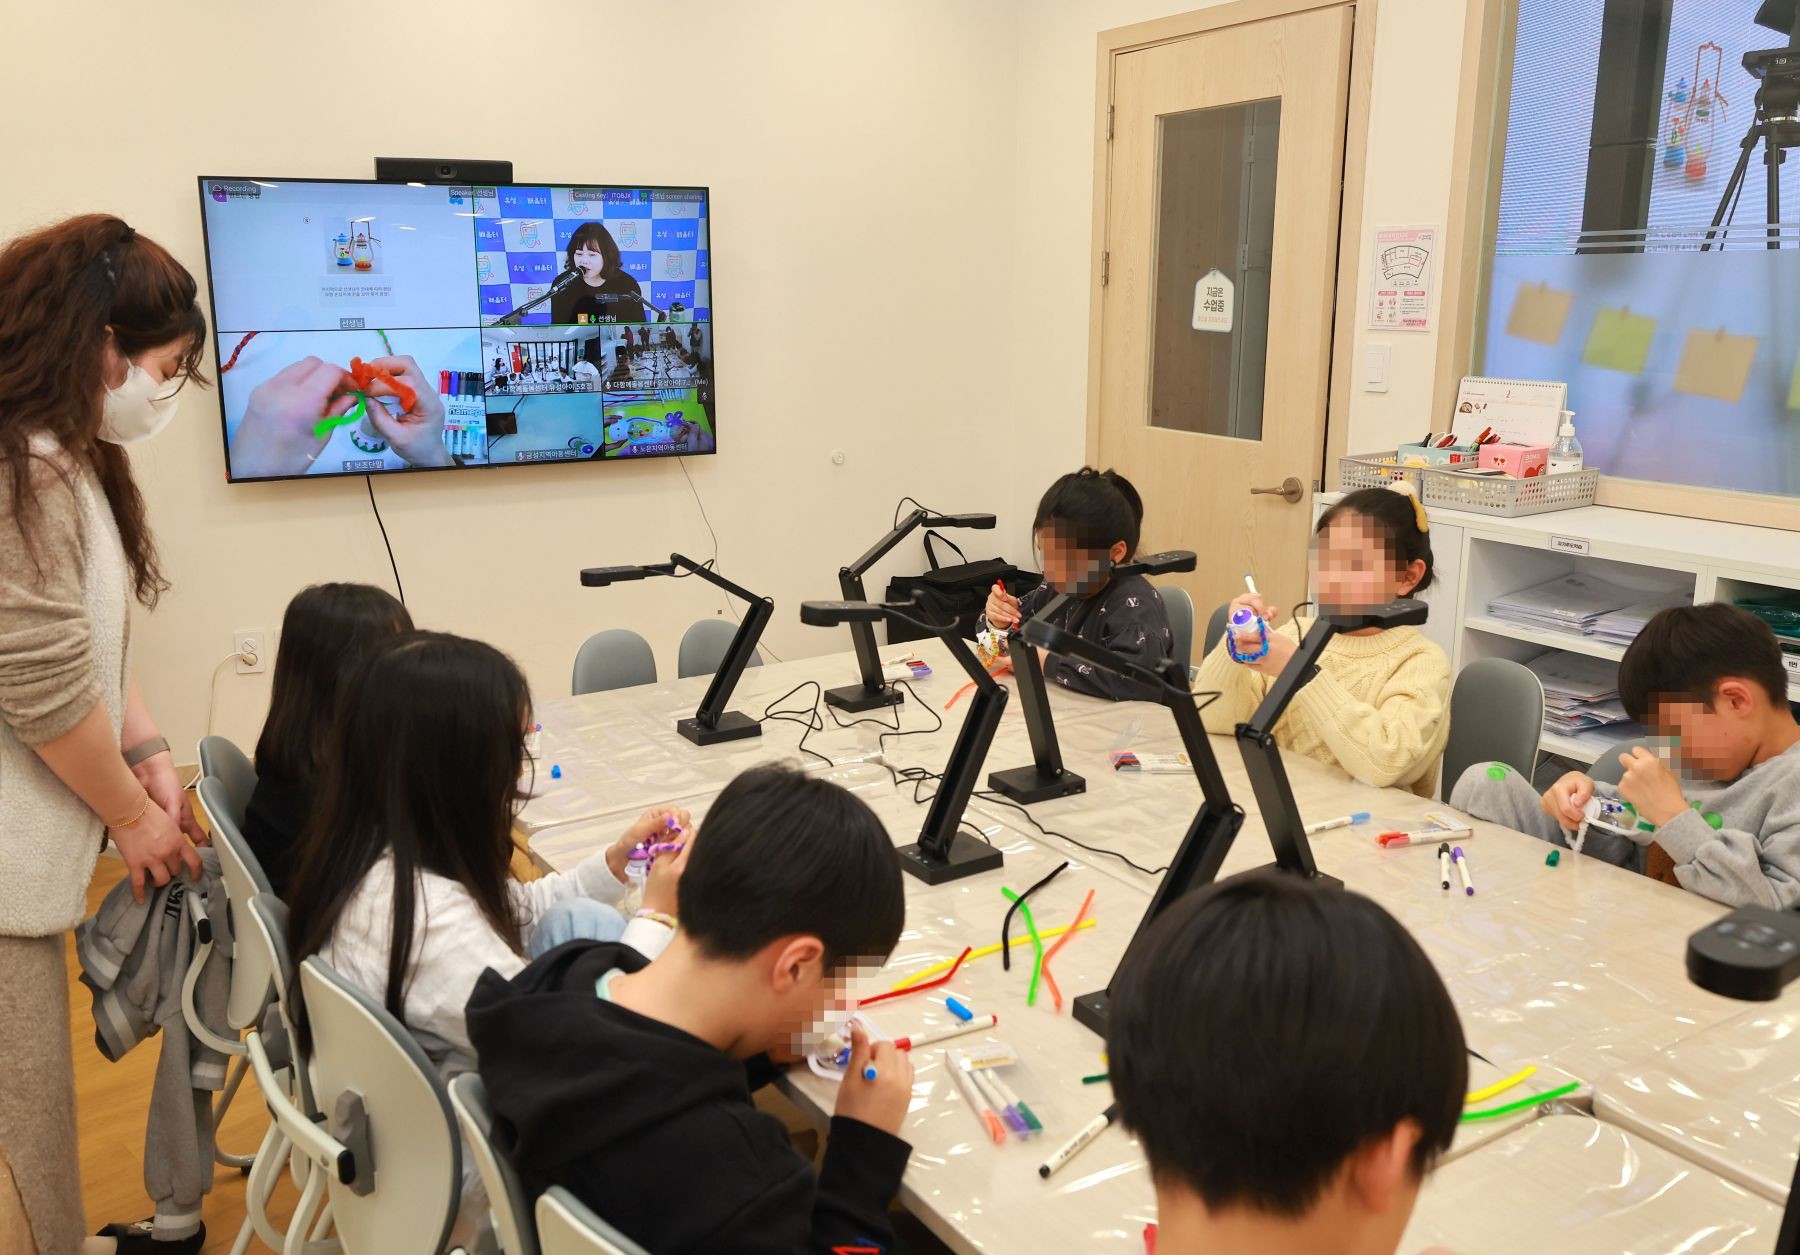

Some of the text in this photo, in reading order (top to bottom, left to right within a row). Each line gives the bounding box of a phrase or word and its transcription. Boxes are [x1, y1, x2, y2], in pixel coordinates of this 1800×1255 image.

[224, 185, 256, 193] Recording
[527, 197, 546, 205] 배움터
[1206, 287, 1223, 298] 지금은
[1203, 299, 1225, 312] 수업중
[598, 314, 617, 322] 선생님
[342, 320, 363, 328] 선생님
[1506, 390, 1511, 398] 2
